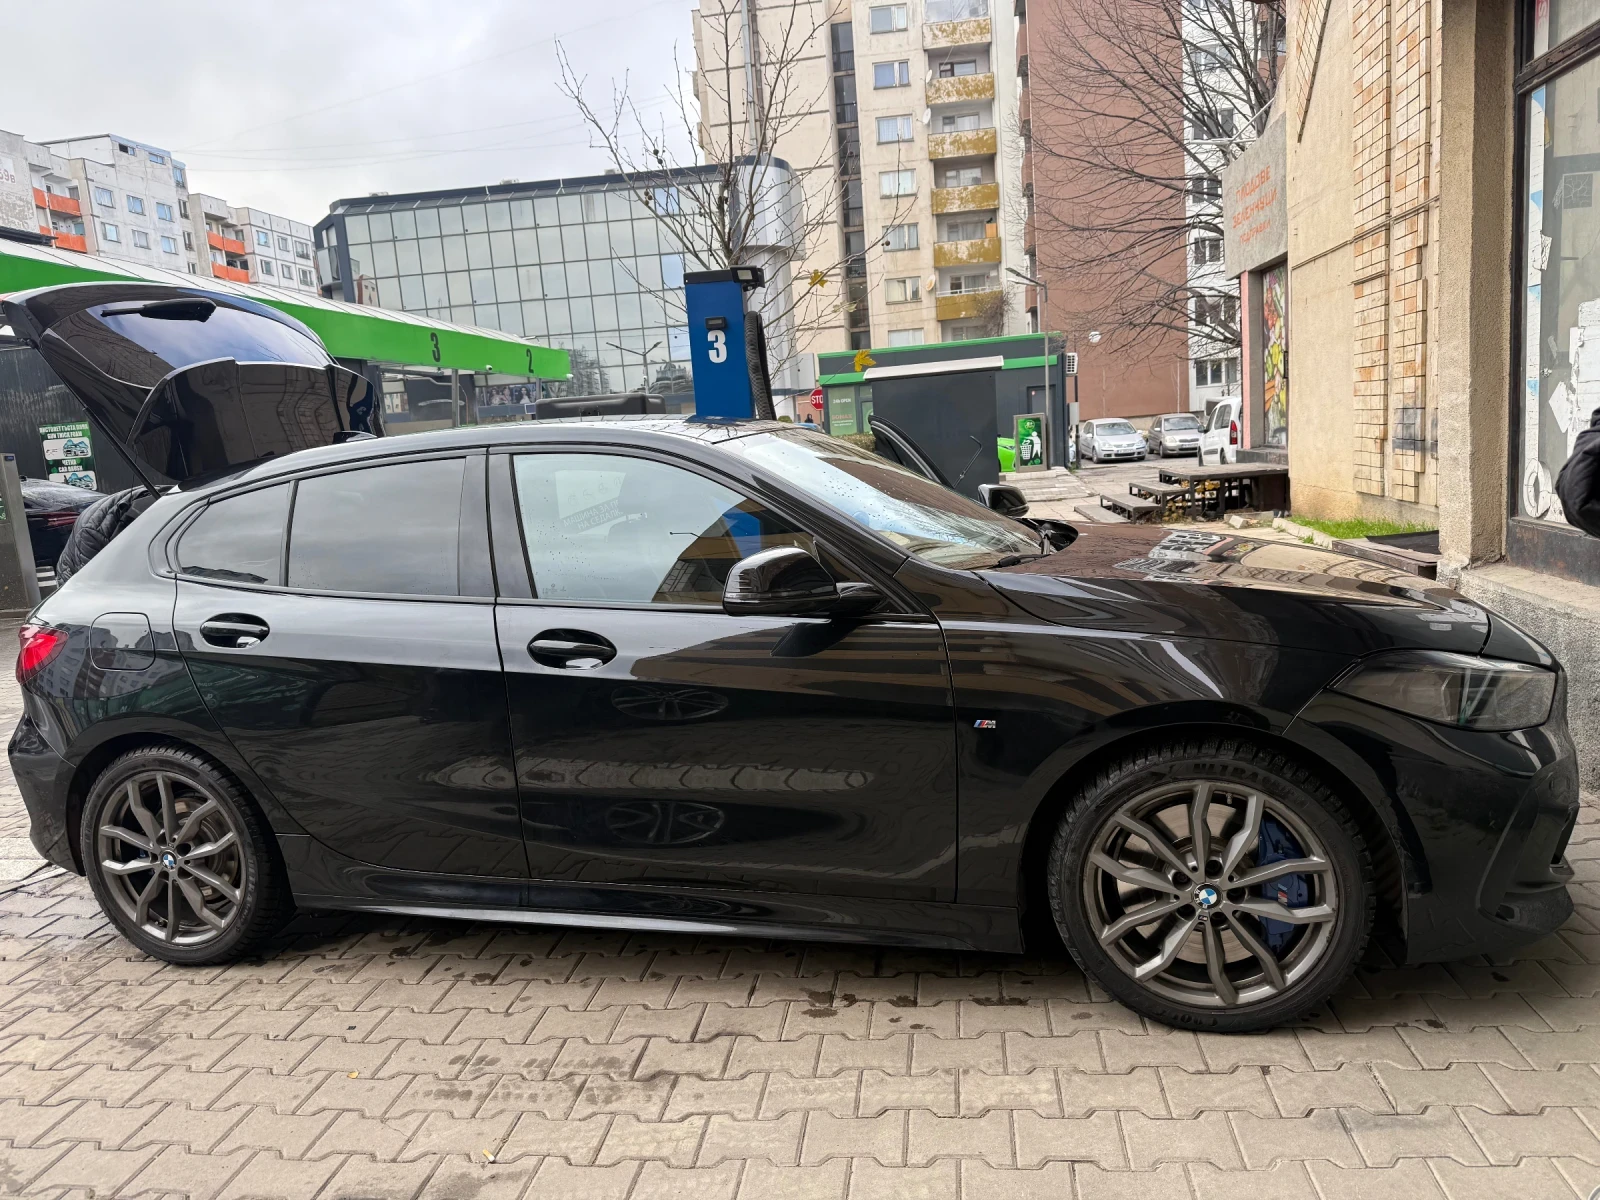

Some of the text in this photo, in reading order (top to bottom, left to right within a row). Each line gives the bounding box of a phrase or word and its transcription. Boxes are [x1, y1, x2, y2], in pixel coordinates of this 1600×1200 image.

[430, 332, 441, 362] 3
[707, 329, 727, 364] 3
[526, 348, 534, 374] 2
[811, 395, 824, 404] STO
[563, 508, 598, 527] МАШИНА
[600, 504, 610, 514] ЗА
[577, 509, 622, 530] НА СЕДАЛК
